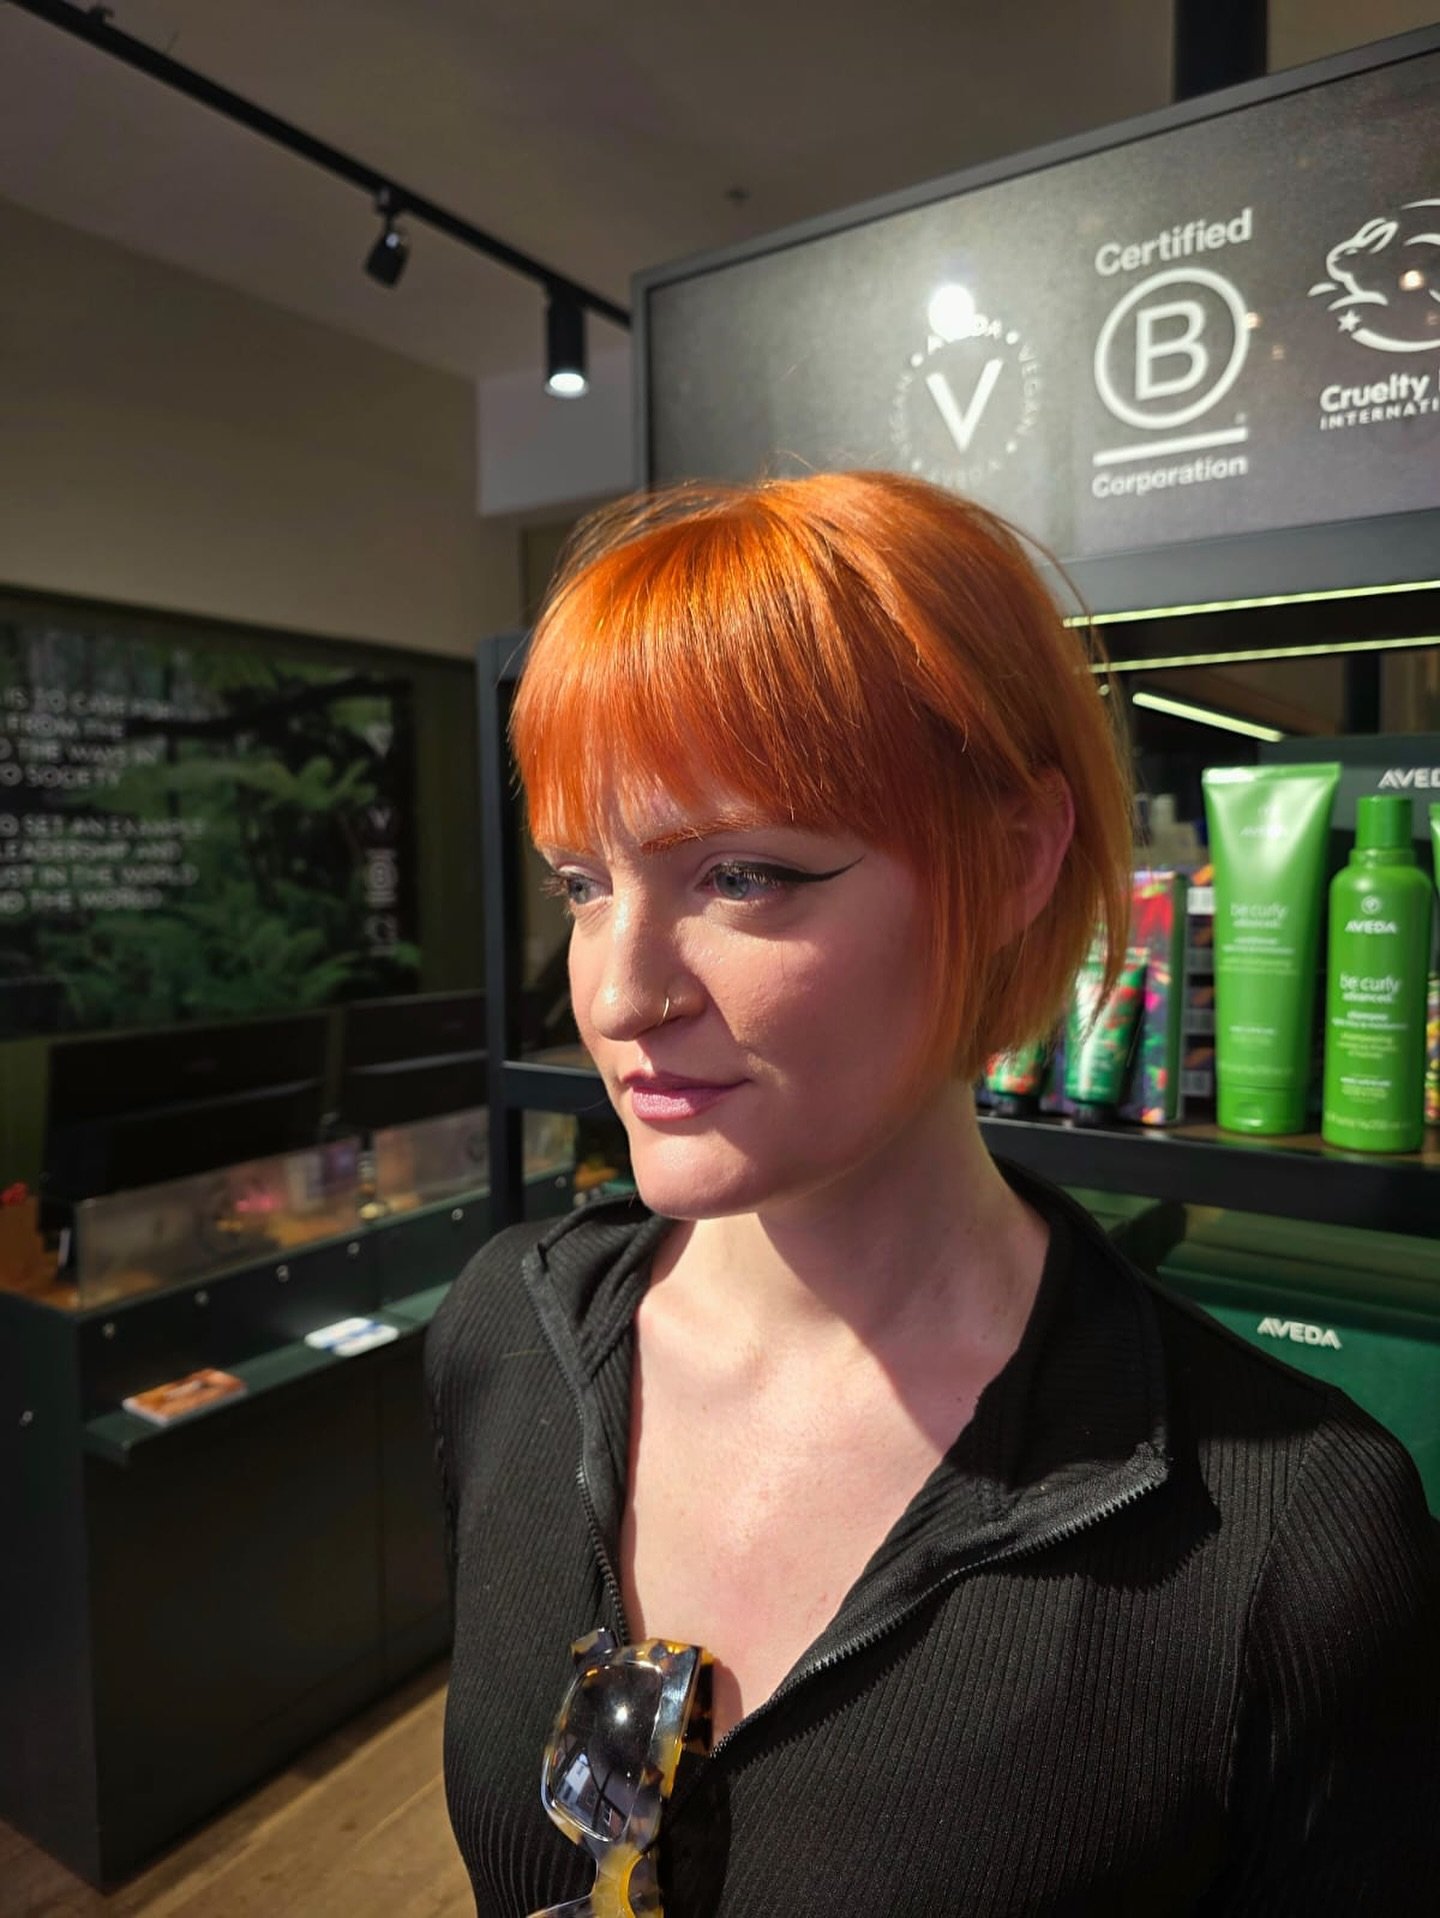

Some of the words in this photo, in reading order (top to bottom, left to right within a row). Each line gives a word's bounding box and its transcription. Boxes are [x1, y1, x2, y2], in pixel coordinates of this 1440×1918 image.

[1095, 207, 1253, 277] Certified
[927, 313, 1003, 356] ADA
[1134, 300, 1209, 401] B
[926, 357, 1004, 453] V
[1320, 373, 1430, 413] Cruelty
[1320, 397, 1440, 431] INTERNATI
[1092, 454, 1248, 499] Corporation
[0, 761, 23, 787] O
[1377, 766, 1440, 790] AVED
[0, 812, 20, 838] O
[1344, 919, 1399, 935] AVEDA
[1339, 972, 1359, 992] be
[1359, 974, 1401, 996] curly
[1257, 1316, 1343, 1351] AVEDA
